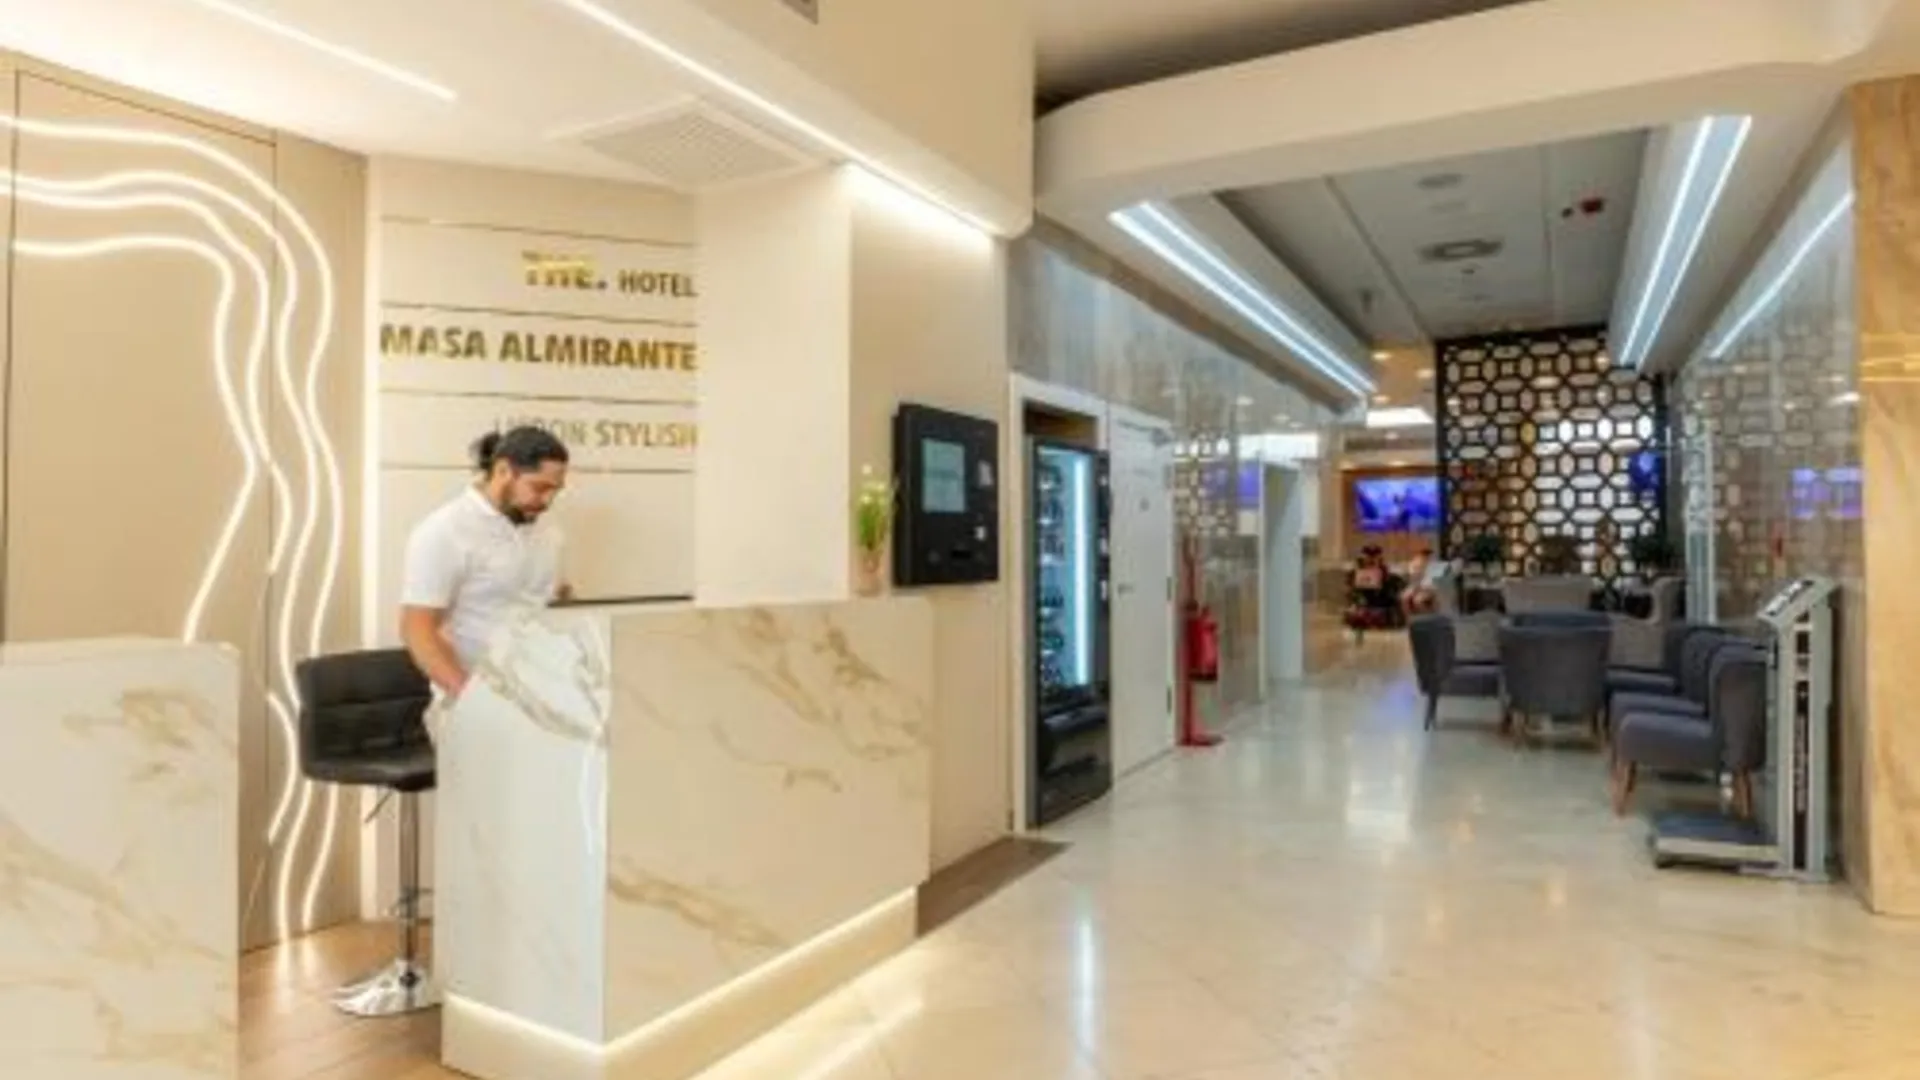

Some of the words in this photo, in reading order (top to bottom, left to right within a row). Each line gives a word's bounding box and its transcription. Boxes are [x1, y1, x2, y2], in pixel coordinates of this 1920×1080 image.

[618, 270, 698, 298] HOTEL
[380, 325, 485, 359] MASA
[499, 331, 698, 371] ALMIRANTE
